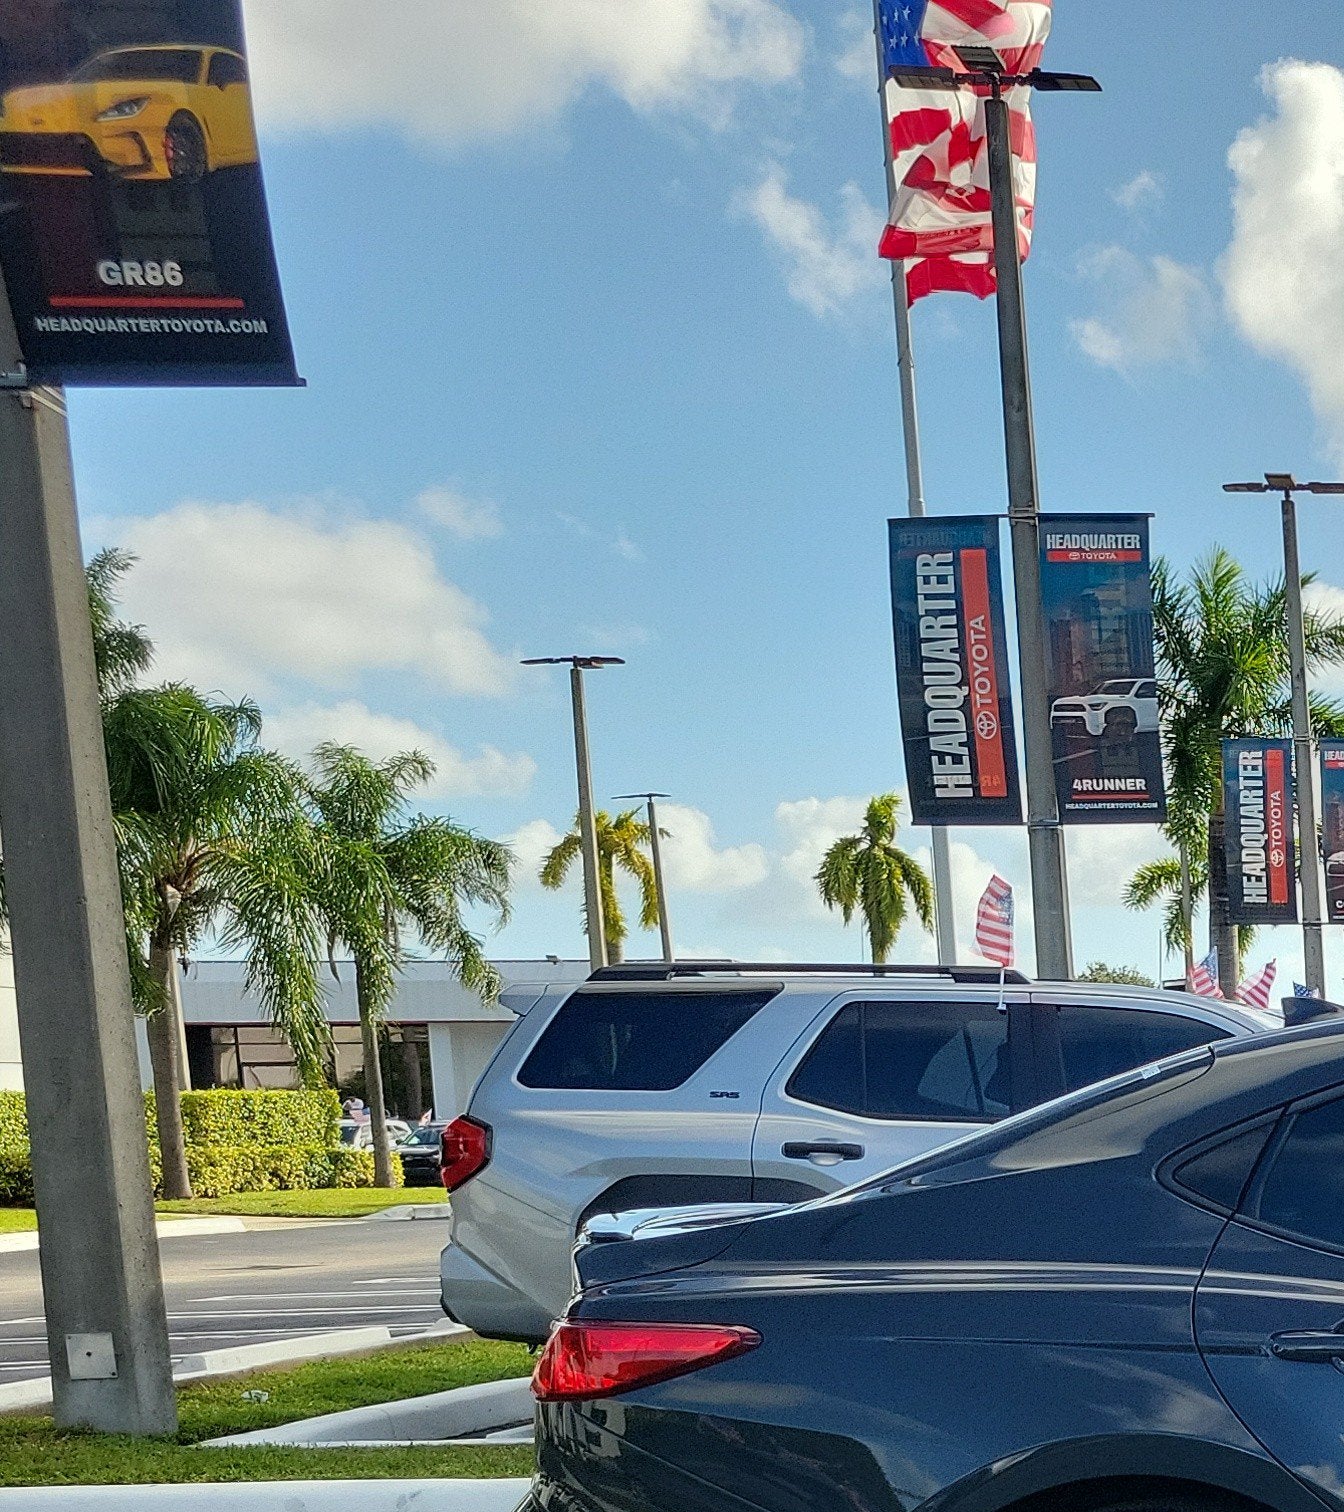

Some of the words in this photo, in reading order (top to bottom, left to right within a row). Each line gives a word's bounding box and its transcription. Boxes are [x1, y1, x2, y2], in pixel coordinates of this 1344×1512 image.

[98, 261, 184, 287] GR86
[35, 316, 268, 335] HEADQUARTERTOYOTA.COM
[1046, 533, 1141, 551] HEADQUARTER
[1081, 552, 1117, 560] TOYOTA
[969, 614, 993, 708] TOYOTA
[915, 551, 975, 798] HEADQUARTER
[1072, 778, 1147, 791] 4RUNNER
[1239, 750, 1268, 904] HEADQUARTER
[1270, 790, 1282, 848] TOYOTA
[709, 1091, 740, 1099] SR5
